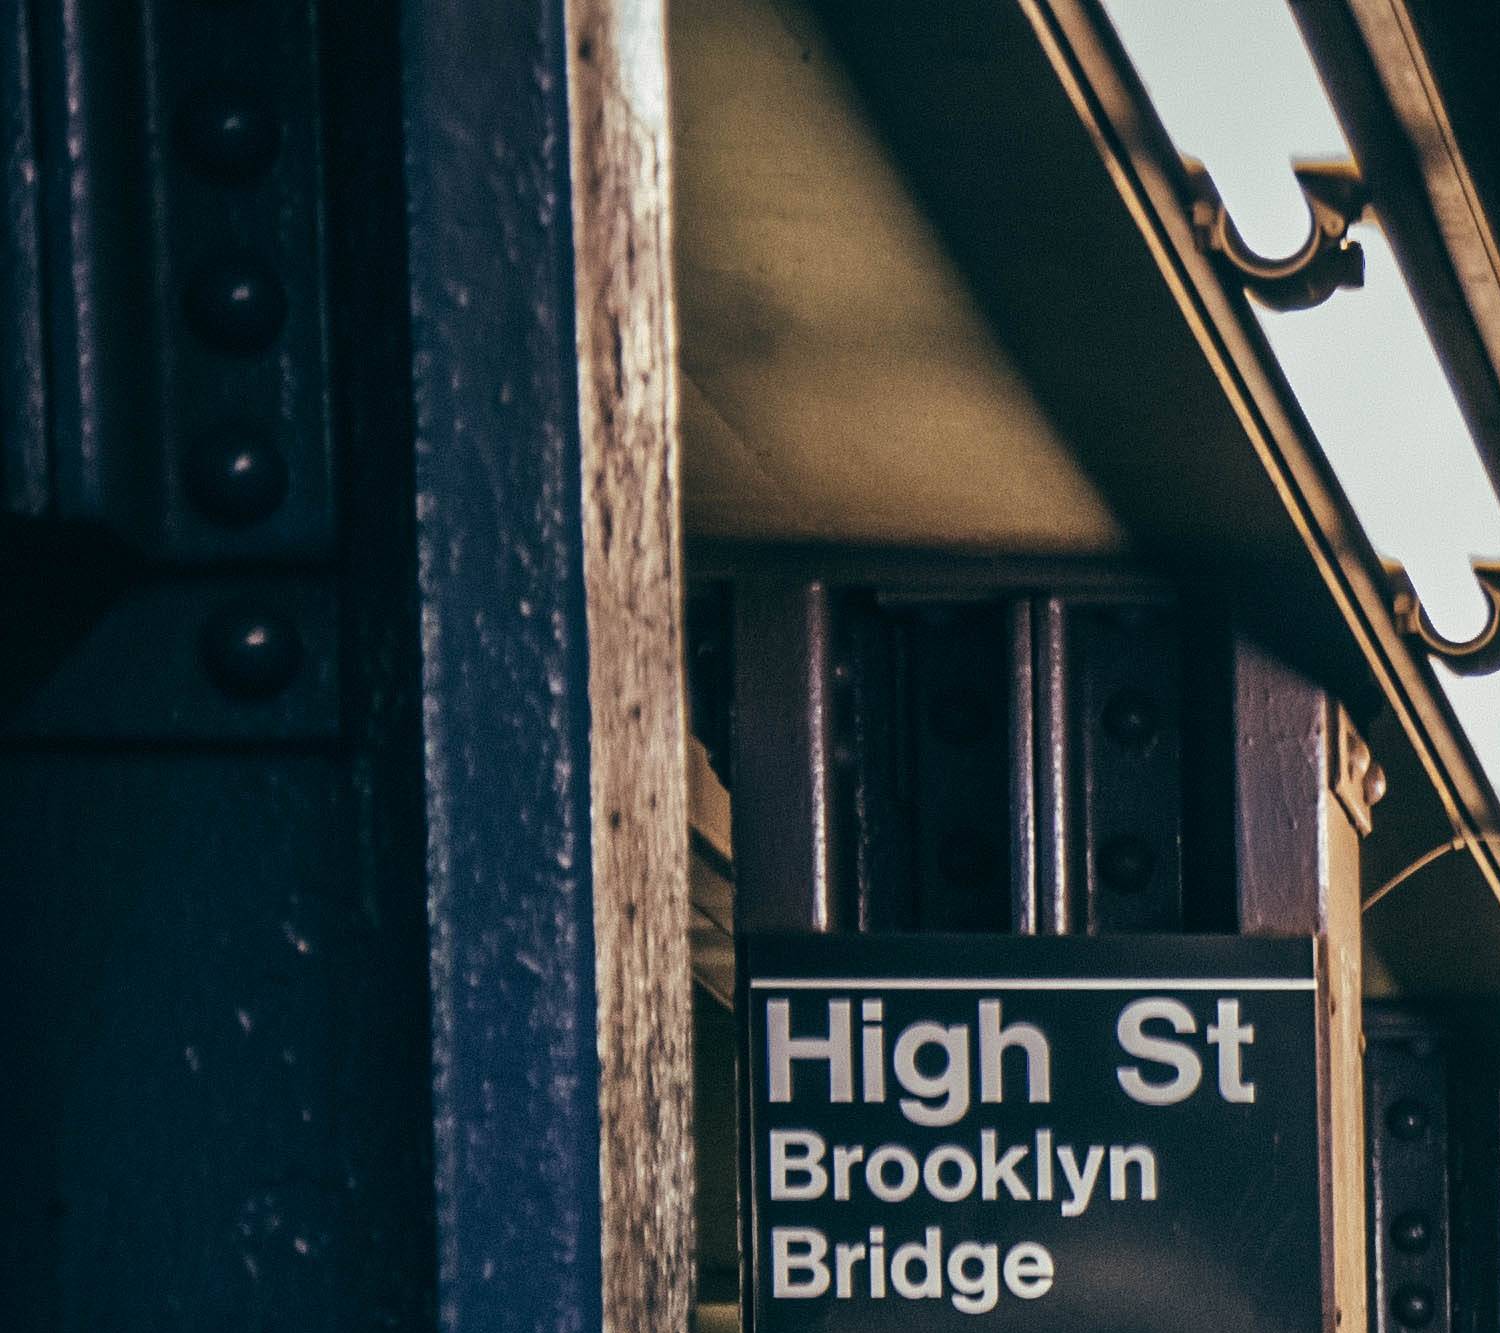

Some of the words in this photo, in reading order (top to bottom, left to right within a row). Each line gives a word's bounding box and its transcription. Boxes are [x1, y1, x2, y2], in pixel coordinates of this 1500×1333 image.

[766, 998, 1051, 1127] High
[1116, 997, 1256, 1106] St
[769, 1128, 1158, 1217] Brooklyn
[771, 1226, 1056, 1314] Bridge
